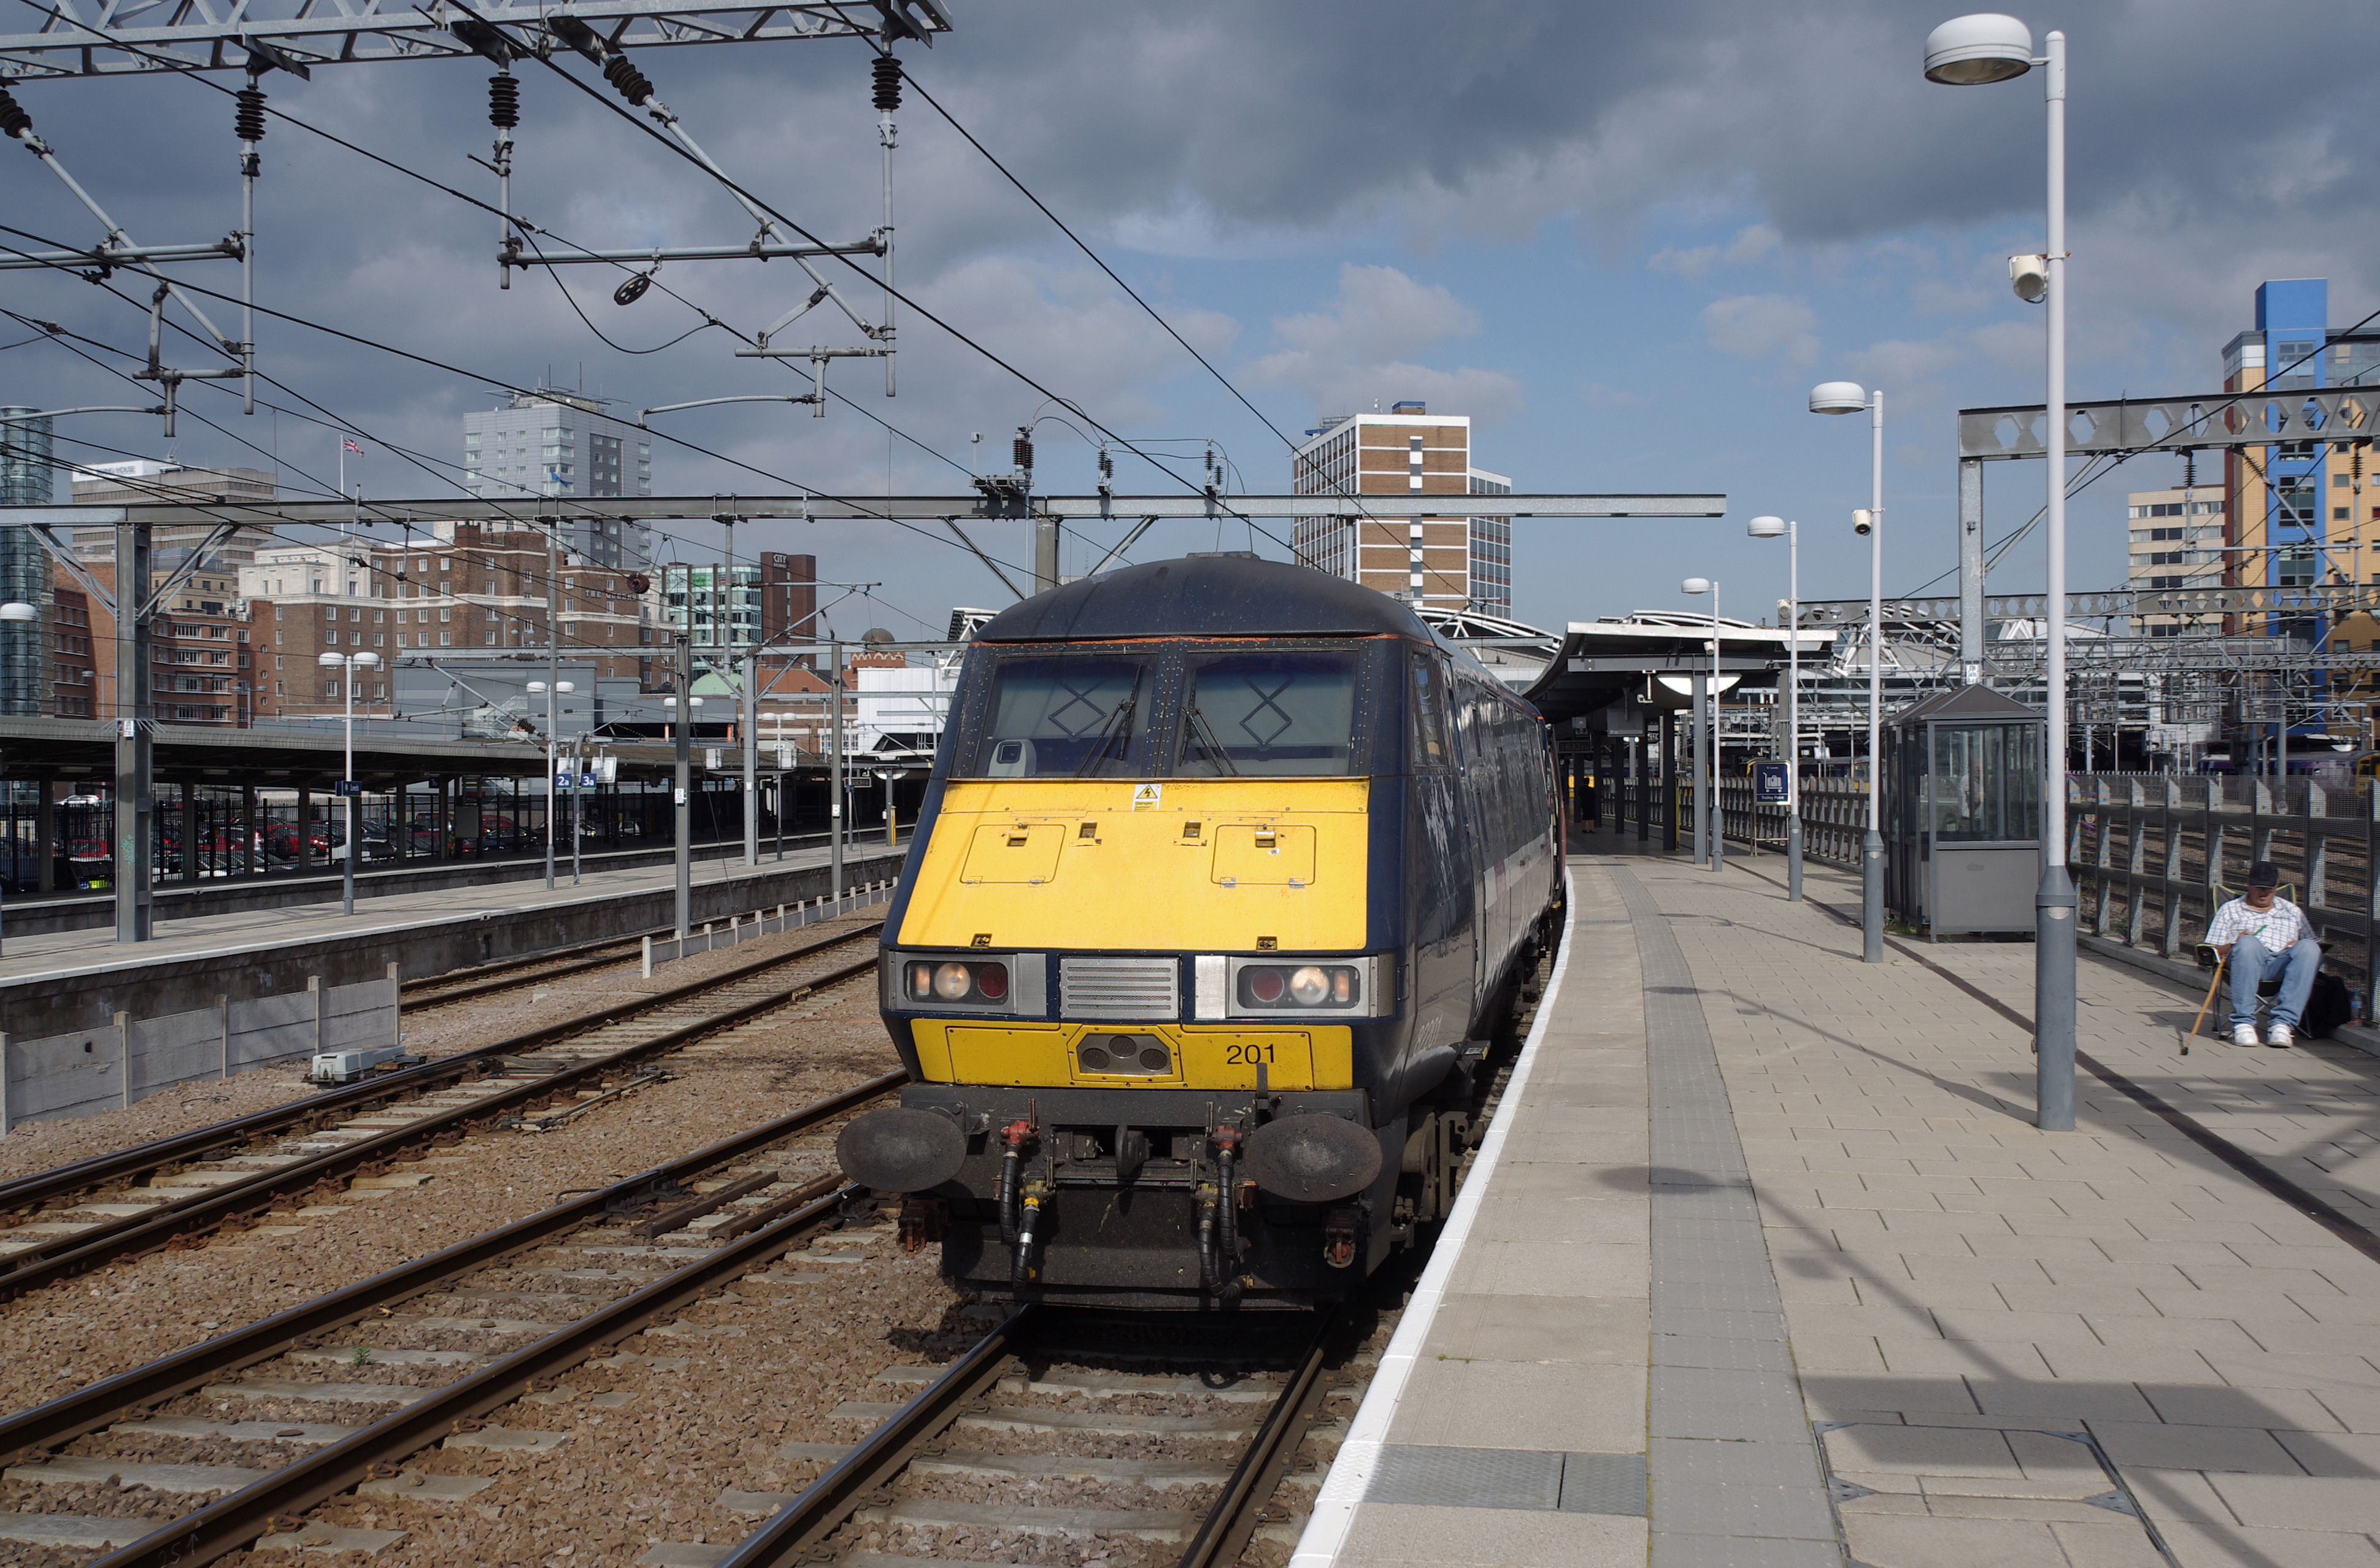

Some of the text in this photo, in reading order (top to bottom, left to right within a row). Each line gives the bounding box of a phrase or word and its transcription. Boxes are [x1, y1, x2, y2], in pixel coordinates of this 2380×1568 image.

[774, 554, 787, 564] CITY
[585, 590, 636, 601] THE QUEENS
[558, 775, 569, 786] 2a
[582, 775, 595, 786] 3a
[1227, 1043, 1274, 1064] 201
